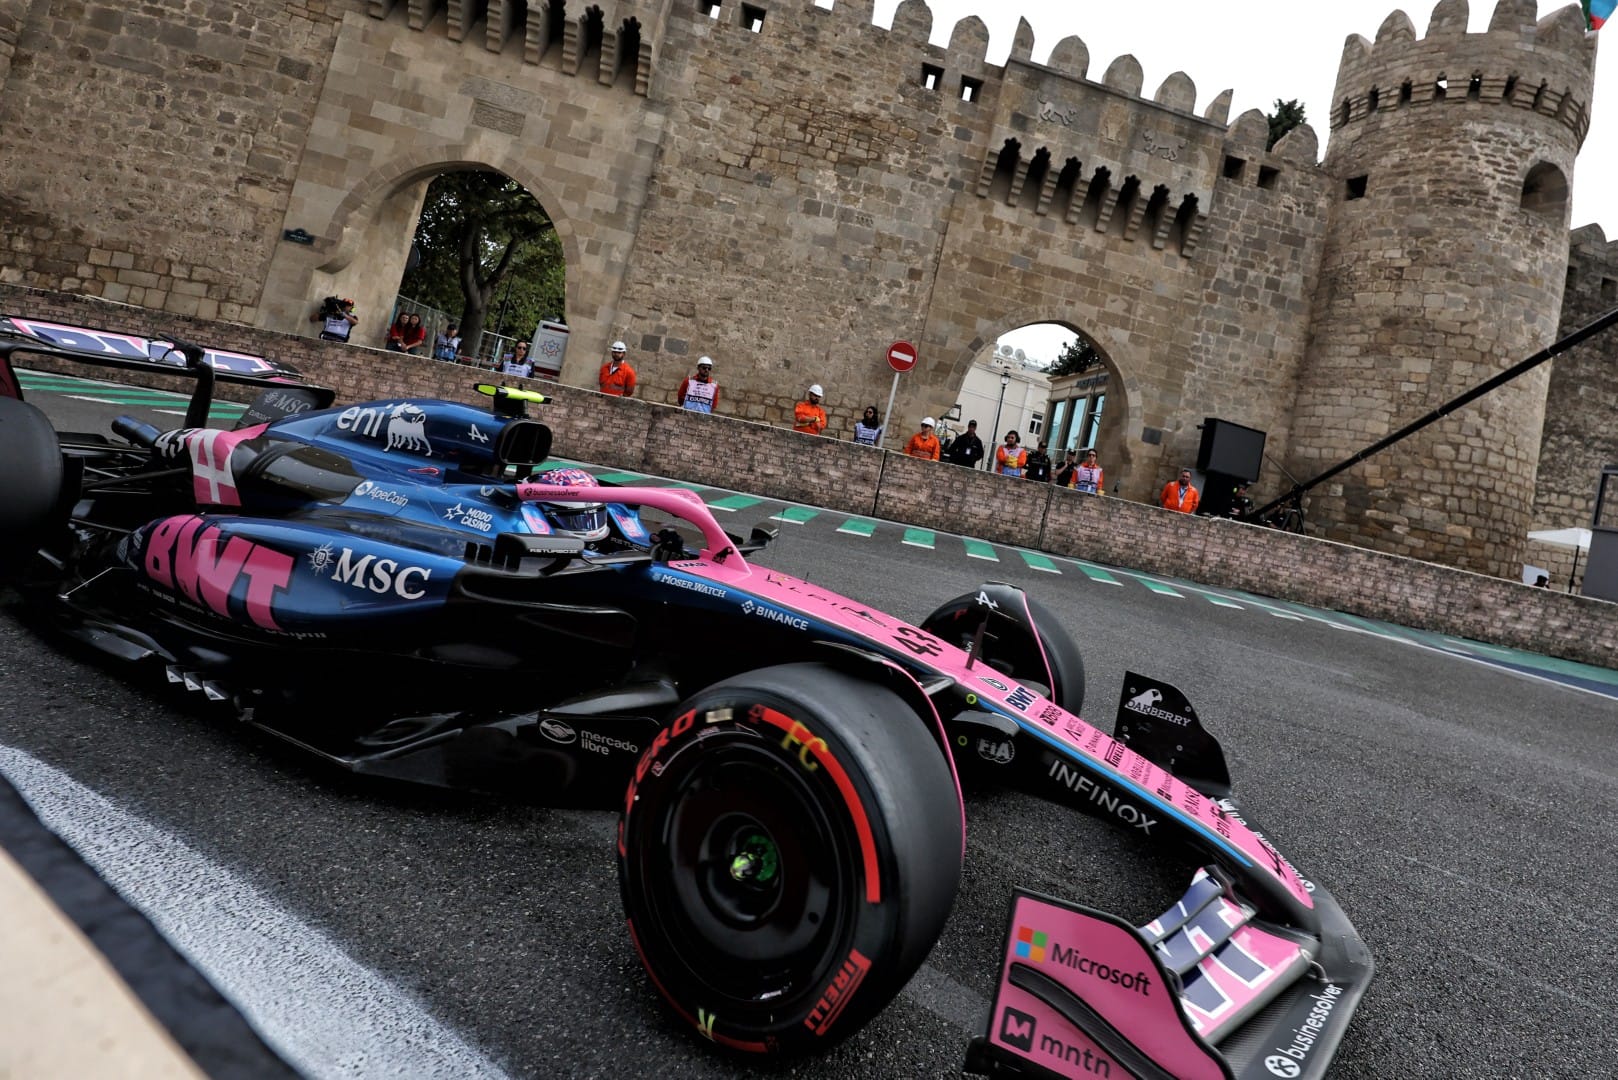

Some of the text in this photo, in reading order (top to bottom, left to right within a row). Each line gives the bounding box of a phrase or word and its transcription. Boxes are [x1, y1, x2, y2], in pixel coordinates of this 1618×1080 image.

[336, 404, 385, 438] eni
[367, 483, 409, 508] ApeCoin
[460, 516, 492, 532] CASINO
[466, 507, 493, 522] MODO
[145, 514, 295, 632] BWT
[331, 548, 432, 599] MSC
[756, 606, 810, 631] BINANCE
[1126, 699, 1192, 727] OAKBERRY
[580, 729, 639, 754] mercado
[581, 737, 610, 756] libre
[979, 738, 1010, 760] FIA
[1103, 740, 1126, 768] PIRELLI
[1048, 759, 1158, 836] INFINOX
[1051, 942, 1152, 996] Microsoft
[804, 947, 873, 1037] PIRELLI
[1275, 983, 1344, 1061] businessolver
[1040, 1033, 1111, 1079] mntn
